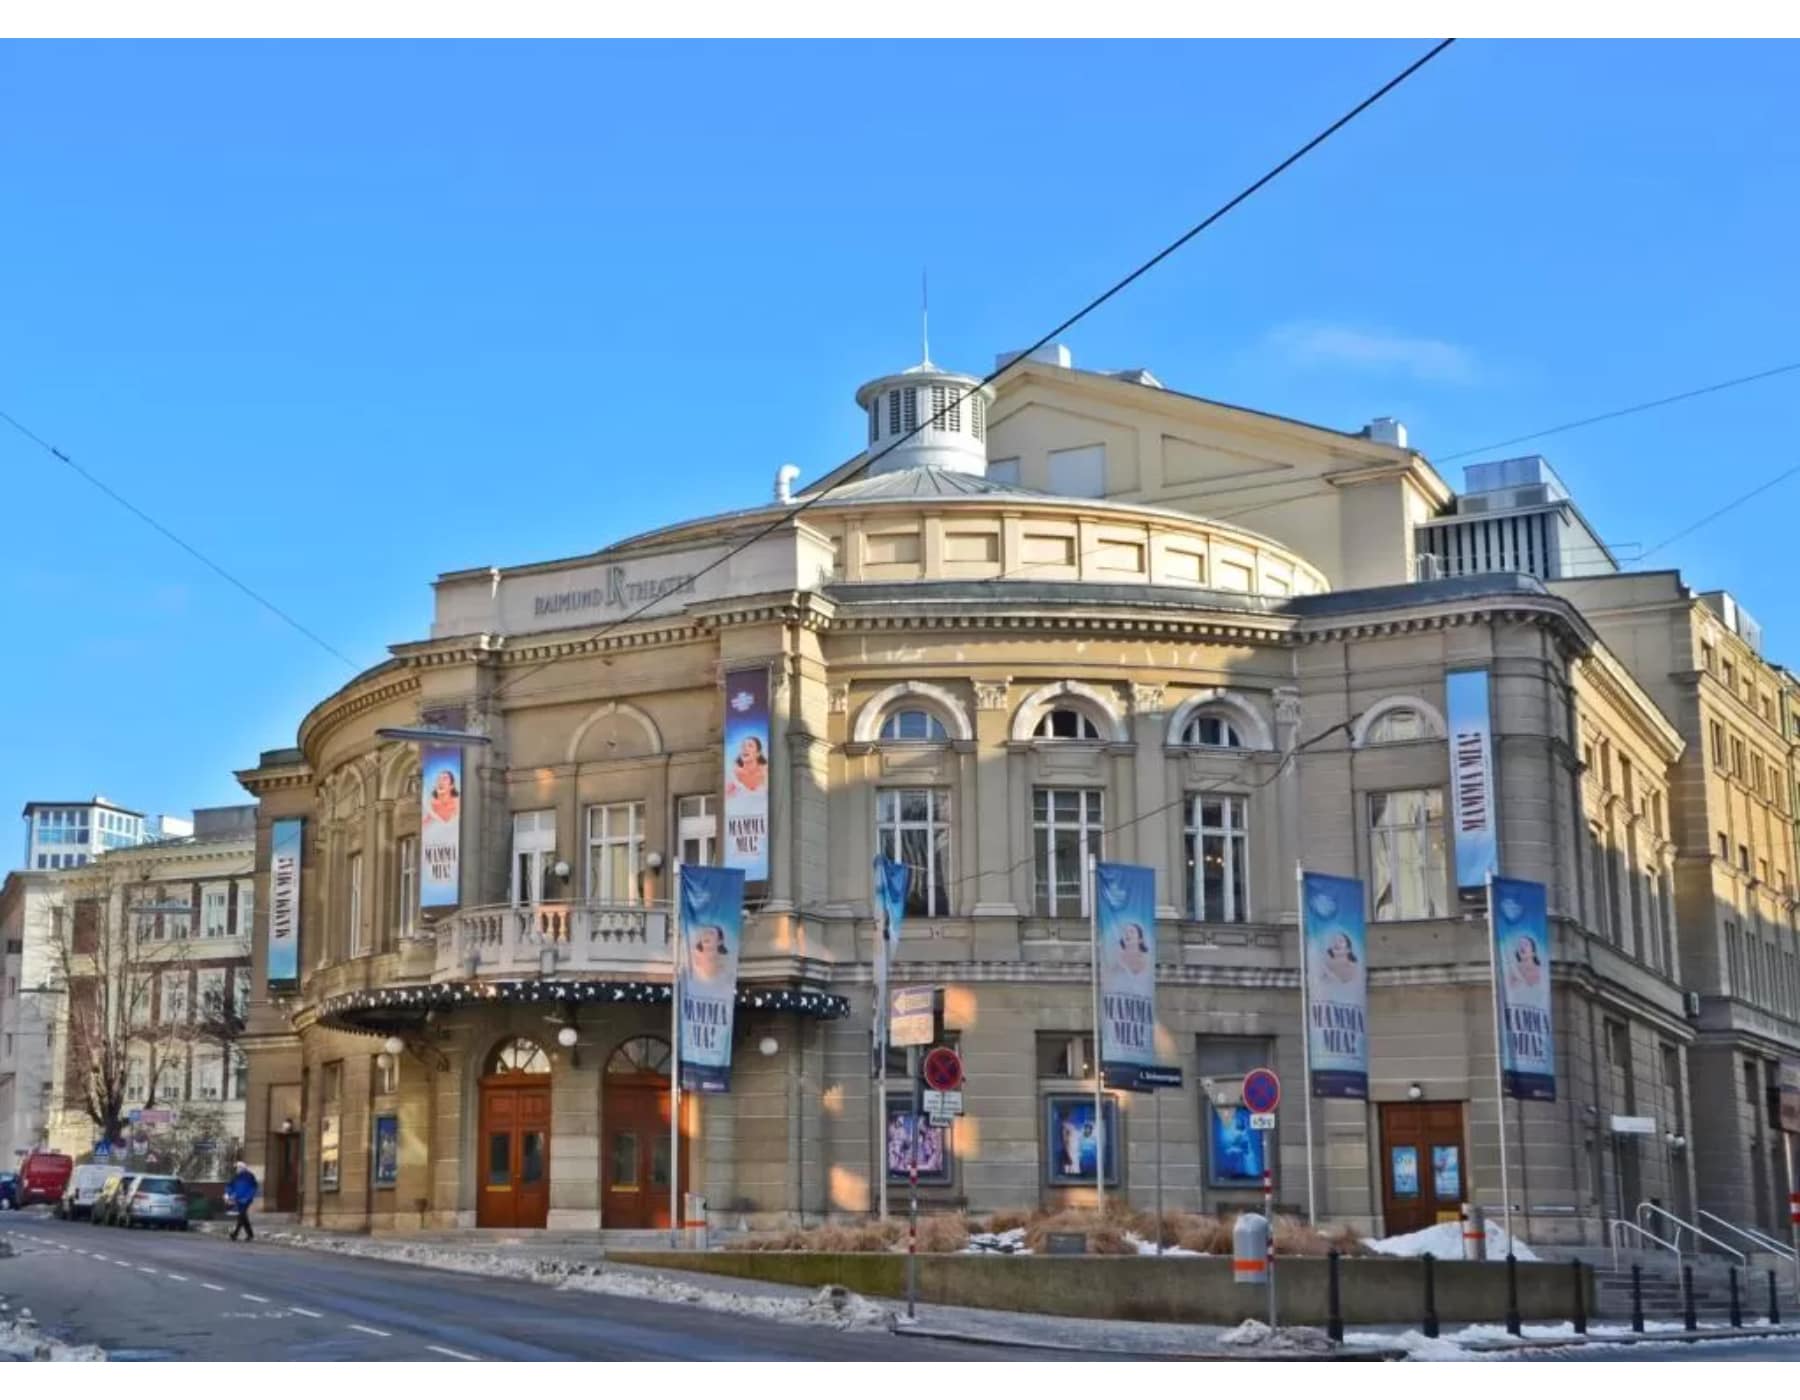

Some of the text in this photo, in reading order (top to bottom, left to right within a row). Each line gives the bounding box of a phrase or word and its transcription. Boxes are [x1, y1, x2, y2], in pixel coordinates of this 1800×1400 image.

[534, 589, 602, 616] RAIMUND
[625, 573, 697, 602] THEATER
[1457, 732, 1486, 832] MAMMA MIA!
[729, 815, 765, 837] MAMMA
[424, 846, 457, 864] MAMMA
[735, 835, 759, 851] MIA!
[432, 862, 451, 880] MIA!
[275, 889, 291, 939] MAMMA
[1103, 996, 1154, 1024] MAMMA
[1312, 1004, 1365, 1033] MAMMA
[1114, 1021, 1144, 1048] MIA!
[1323, 1028, 1356, 1054] MIA!
